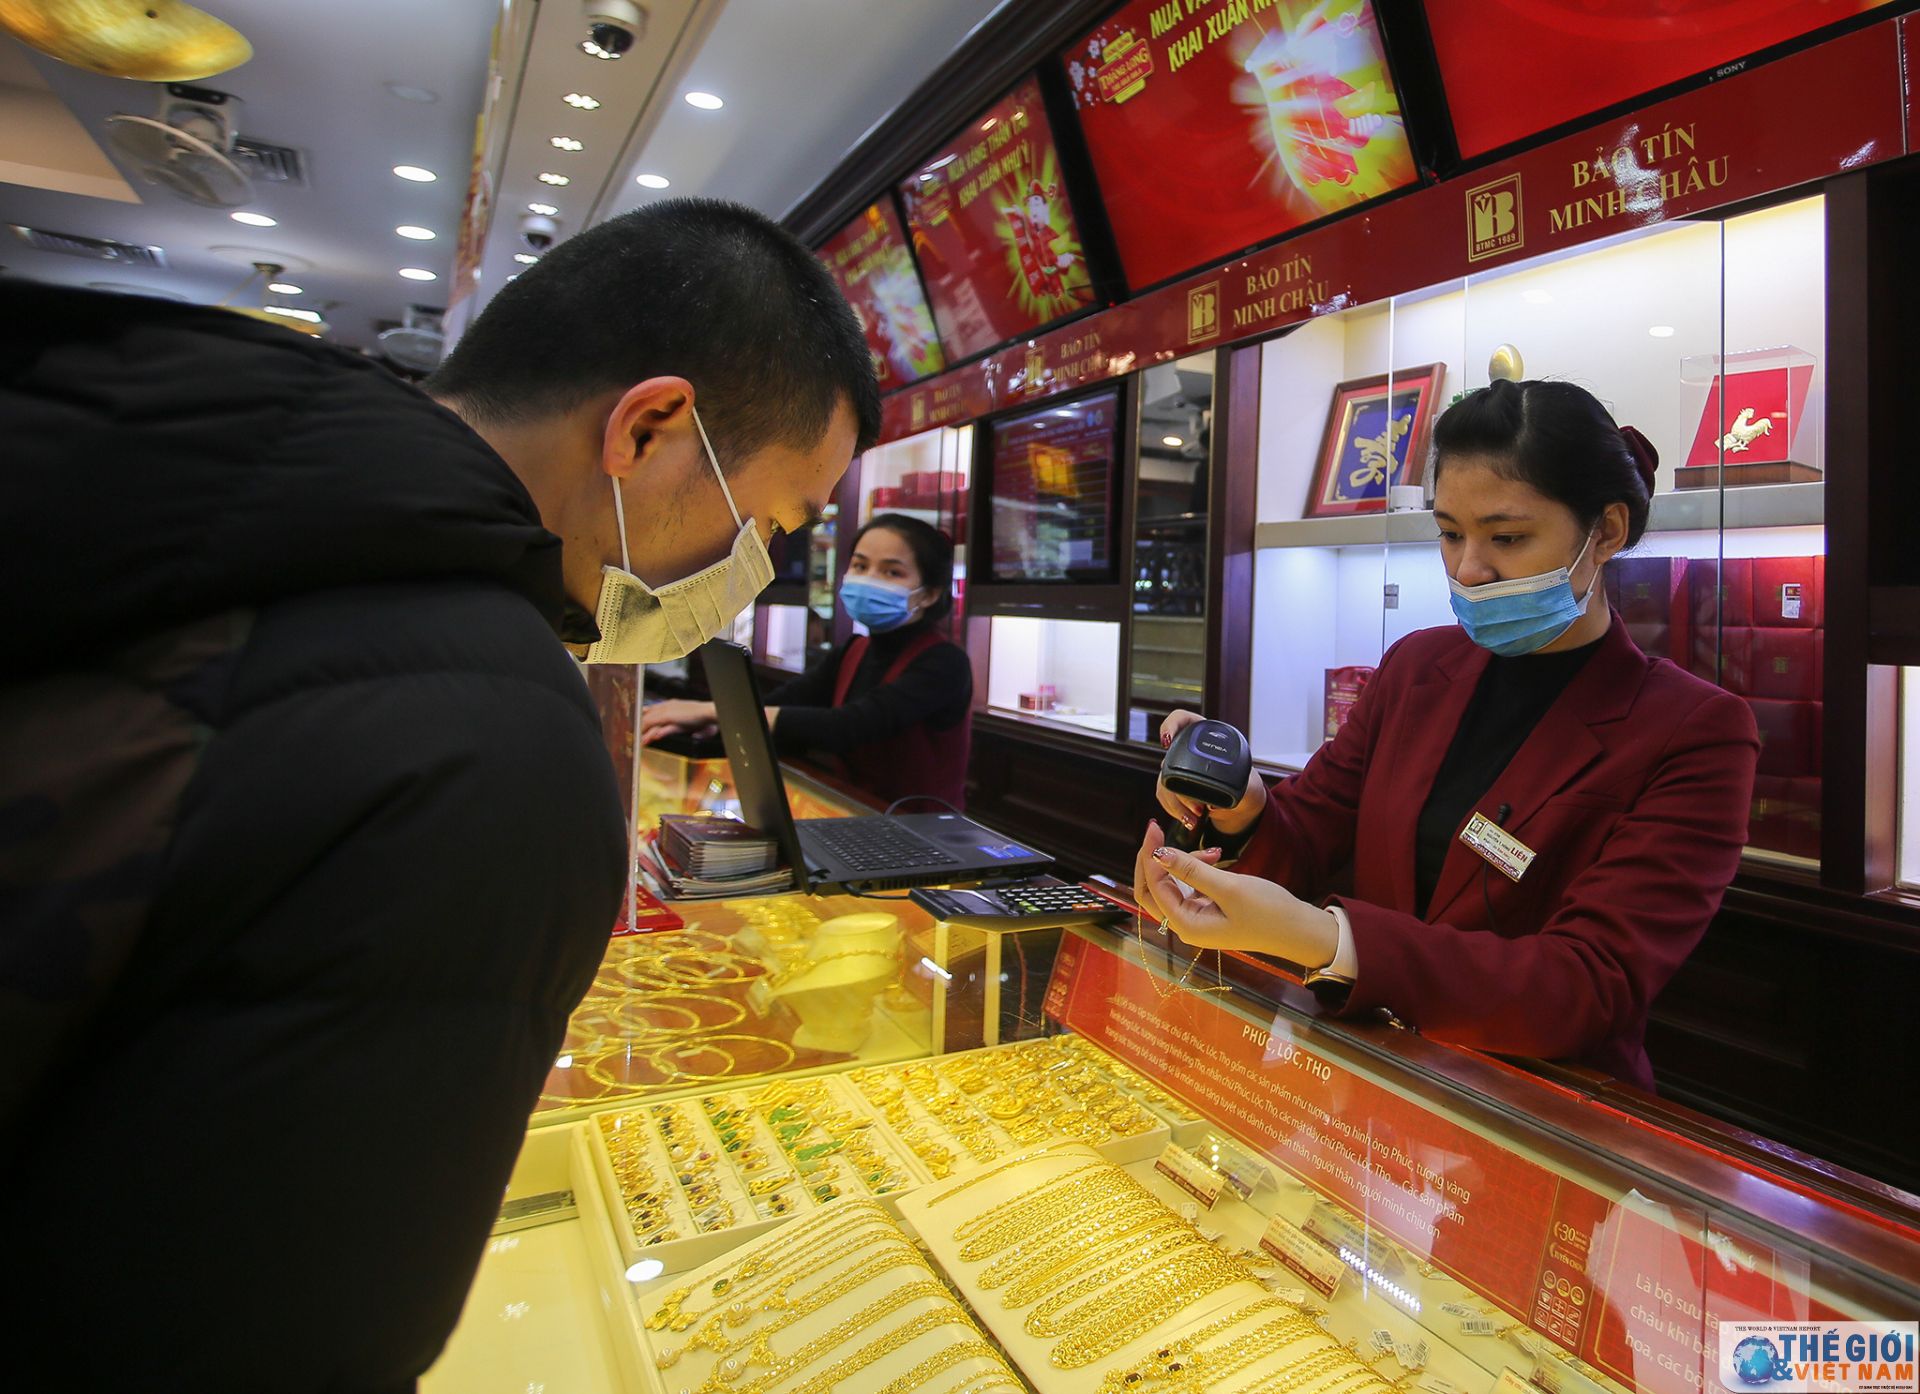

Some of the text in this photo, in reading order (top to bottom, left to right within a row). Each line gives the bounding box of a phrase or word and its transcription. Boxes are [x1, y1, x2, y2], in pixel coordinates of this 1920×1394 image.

[1149, 0, 1184, 39] MUA
[1167, 26, 1204, 72] KHAI
[1205, 0, 1249, 43] XUÂN
[1716, 61, 1747, 77] SONY
[1572, 122, 1696, 189] BẢO TÍN
[1549, 187, 1628, 235] MINH
[1246, 253, 1313, 296] BẢO TÍN
[1475, 238, 1497, 253] BTMC
[1232, 278, 1330, 329] MINH CHÂU
[1242, 1024, 1332, 1085] PHÚC, LỘC, THỌ
[1263, 1123, 1279, 1140] cho
[1405, 1208, 1427, 1232] chịu
[1331, 1116, 1352, 1137] vàng
[1351, 1125, 1372, 1146] hình
[1371, 1137, 1390, 1159] ông
[1390, 1146, 1415, 1172] Phúc,
[1416, 1162, 1445, 1190] tượng
[1446, 1176, 1471, 1205] vàng
[1375, 1163, 1392, 1185] Thọ
[1418, 1189, 1436, 1211] sản
[1434, 1201, 1466, 1227] phẩm
[1629, 1303, 1663, 1334] châu
[1666, 1320, 1691, 1347] khi
[1635, 1272, 1720, 1334] Là bộ sưu tậ
[1624, 1328, 1655, 1362] hoa,
[1656, 1352, 1683, 1377] các
[1683, 1363, 1704, 1391] bộ
